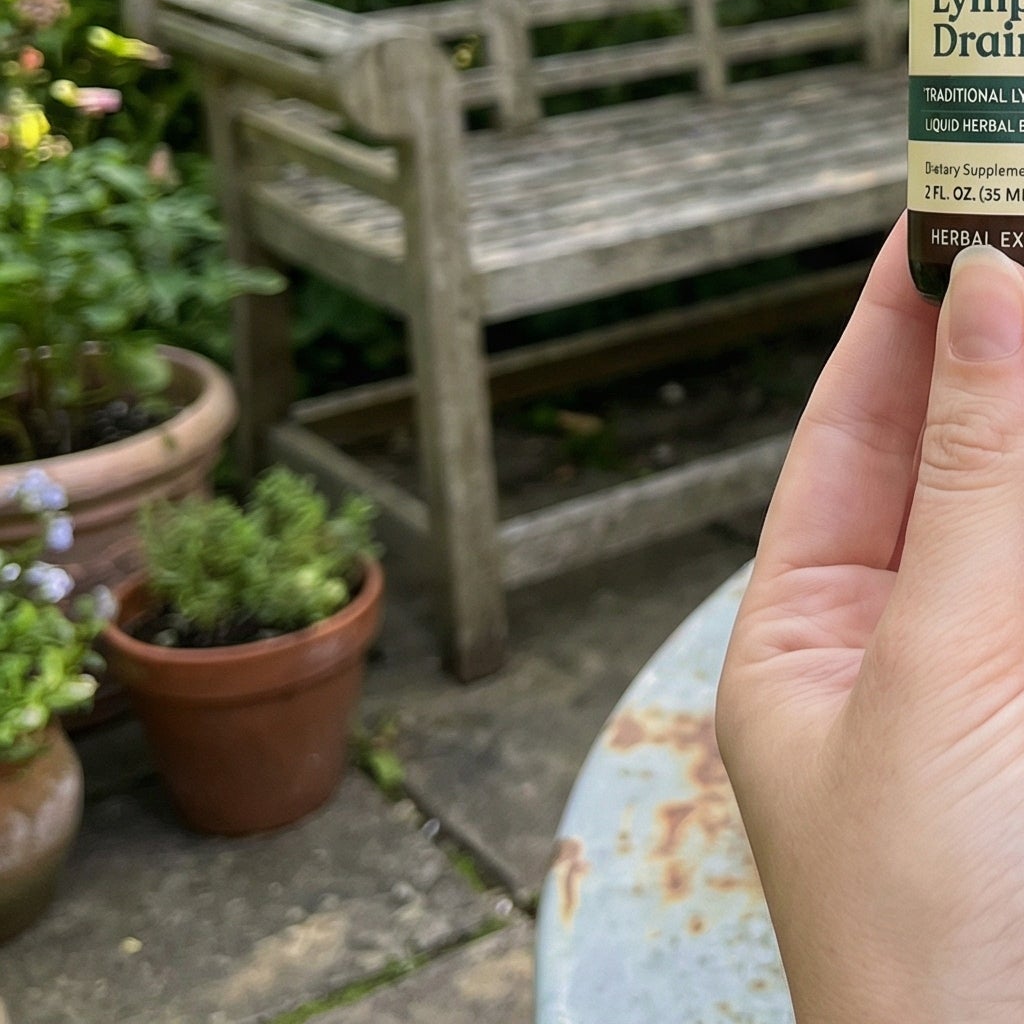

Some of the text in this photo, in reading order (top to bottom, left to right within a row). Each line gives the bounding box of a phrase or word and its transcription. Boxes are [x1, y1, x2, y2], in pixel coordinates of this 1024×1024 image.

[924, 87, 1008, 104] TRADITIONAL
[963, 118, 1015, 133] HERBAL
[925, 185, 931, 200] 2
[933, 185, 950, 200] FL.
[953, 186, 976, 201] OZ.
[979, 185, 1001, 204] (35
